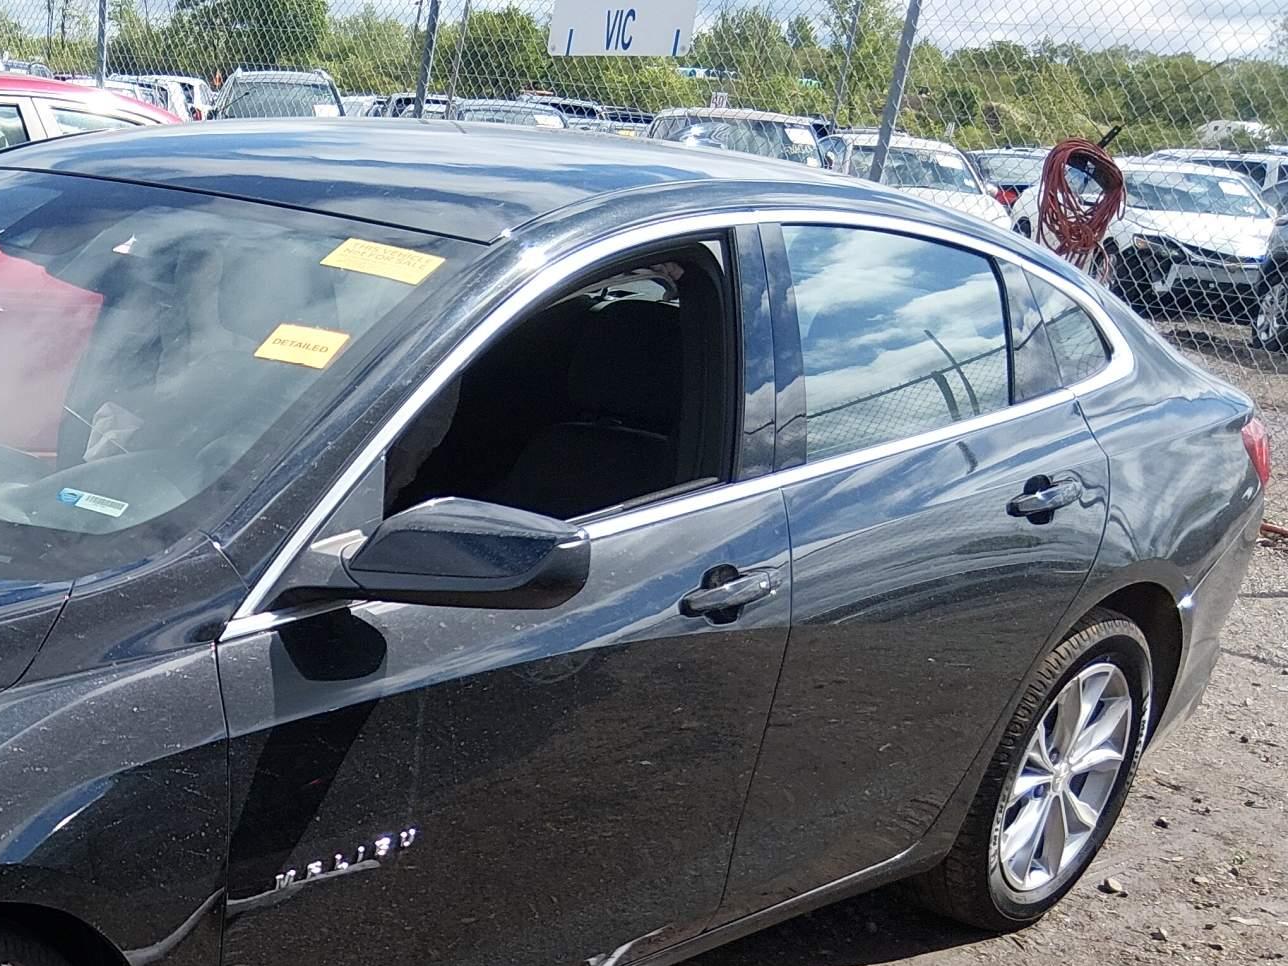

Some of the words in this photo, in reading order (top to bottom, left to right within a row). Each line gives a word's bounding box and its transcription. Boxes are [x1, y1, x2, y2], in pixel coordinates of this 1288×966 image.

[605, 8, 637, 51] VIC
[272, 338, 329, 353] DETAILED
[275, 828, 417, 890] MALIBU
